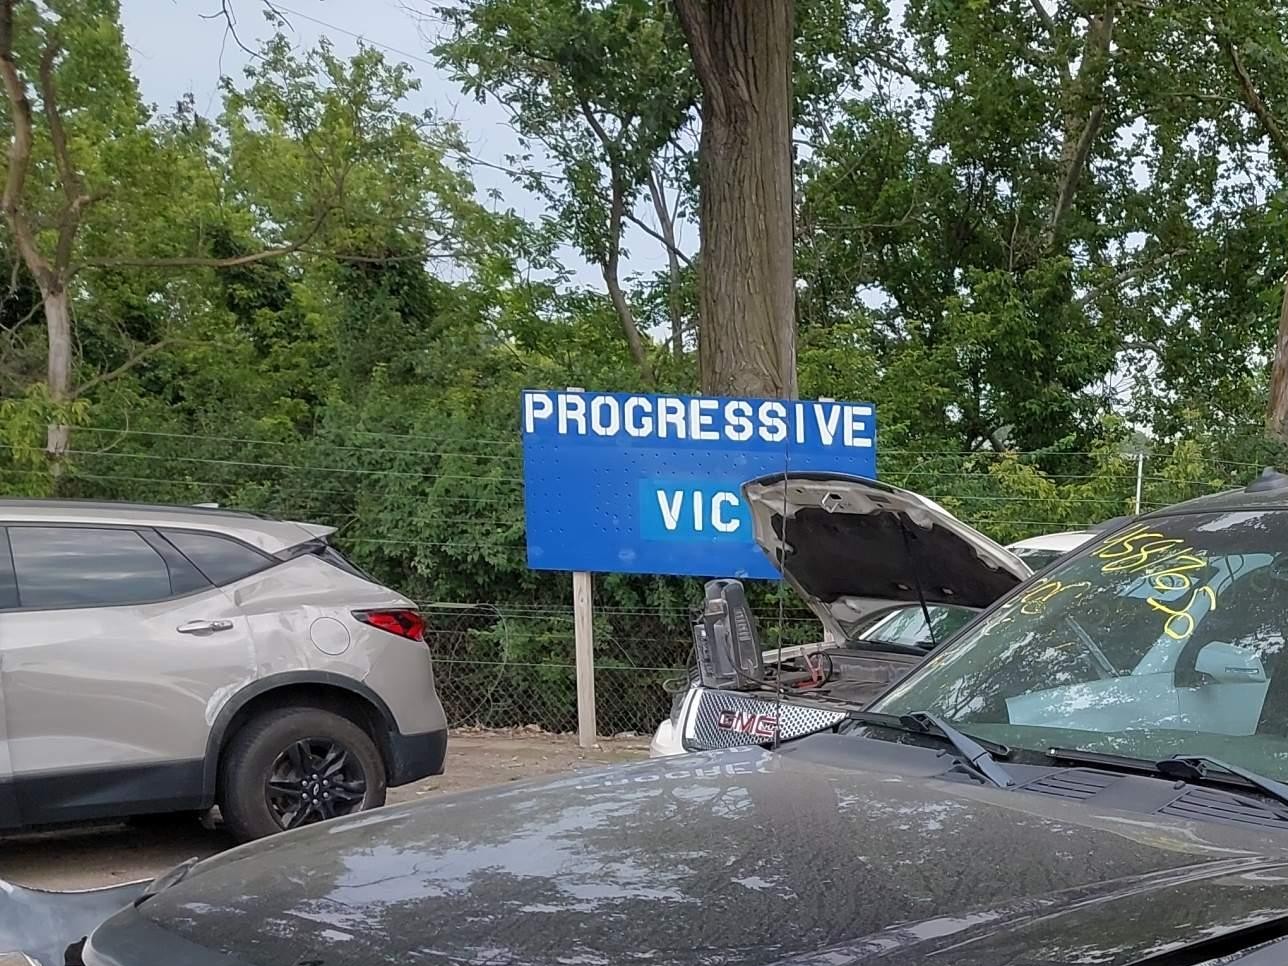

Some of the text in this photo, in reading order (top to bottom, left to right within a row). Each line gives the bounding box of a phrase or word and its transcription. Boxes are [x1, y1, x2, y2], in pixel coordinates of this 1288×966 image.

[525, 393, 873, 447] PROGRESSIVE
[656, 490, 741, 532] VIC
[718, 709, 778, 737] GMC
